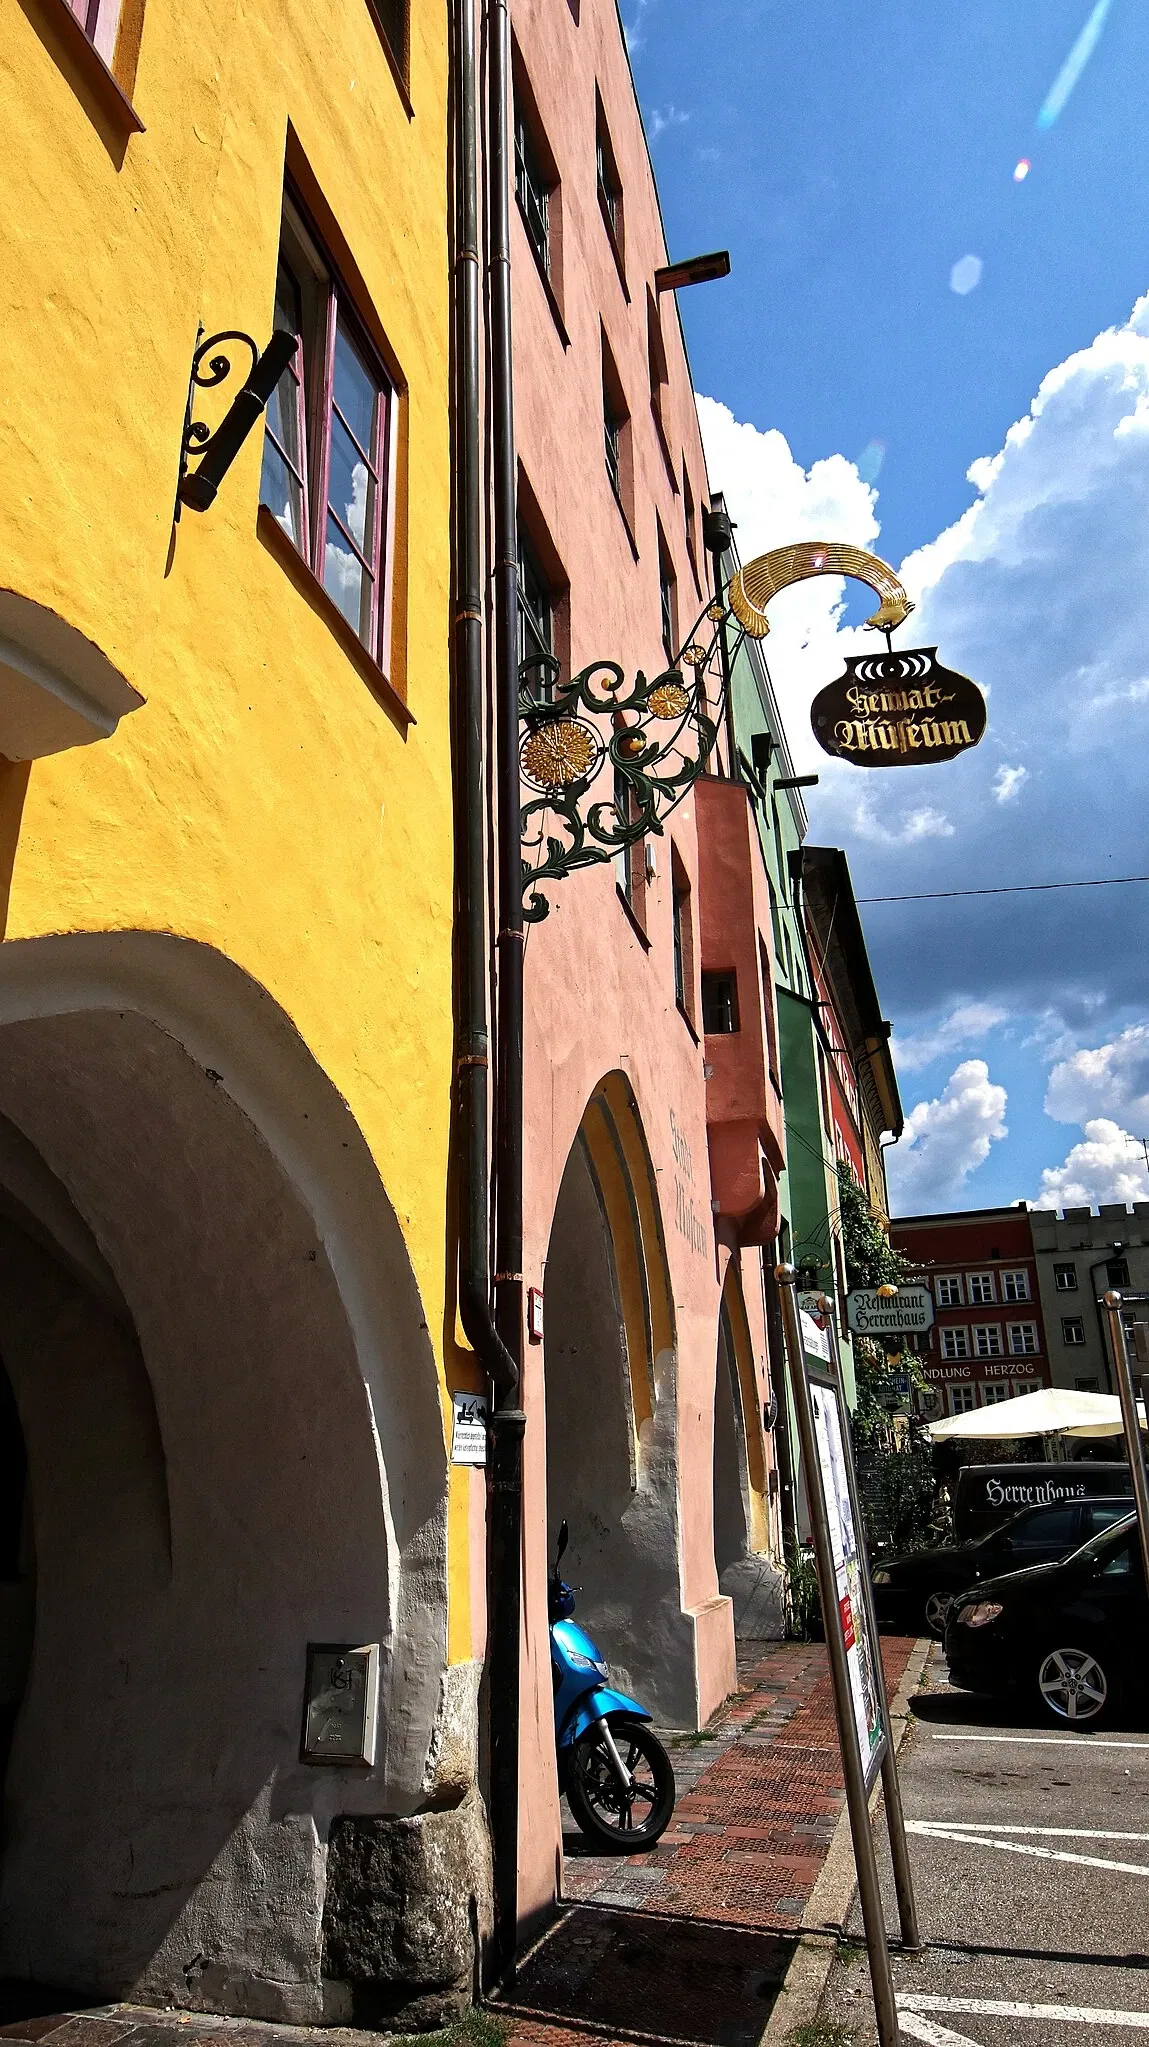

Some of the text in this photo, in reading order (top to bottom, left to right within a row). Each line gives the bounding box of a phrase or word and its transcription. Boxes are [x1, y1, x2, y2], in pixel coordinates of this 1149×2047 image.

[854, 1293, 924, 1312] Restaurant
[856, 1309, 926, 1330] Herrenhaus
[984, 1363, 1034, 1376] HERZOG
[986, 1478, 1086, 1507] Herrenhaus
